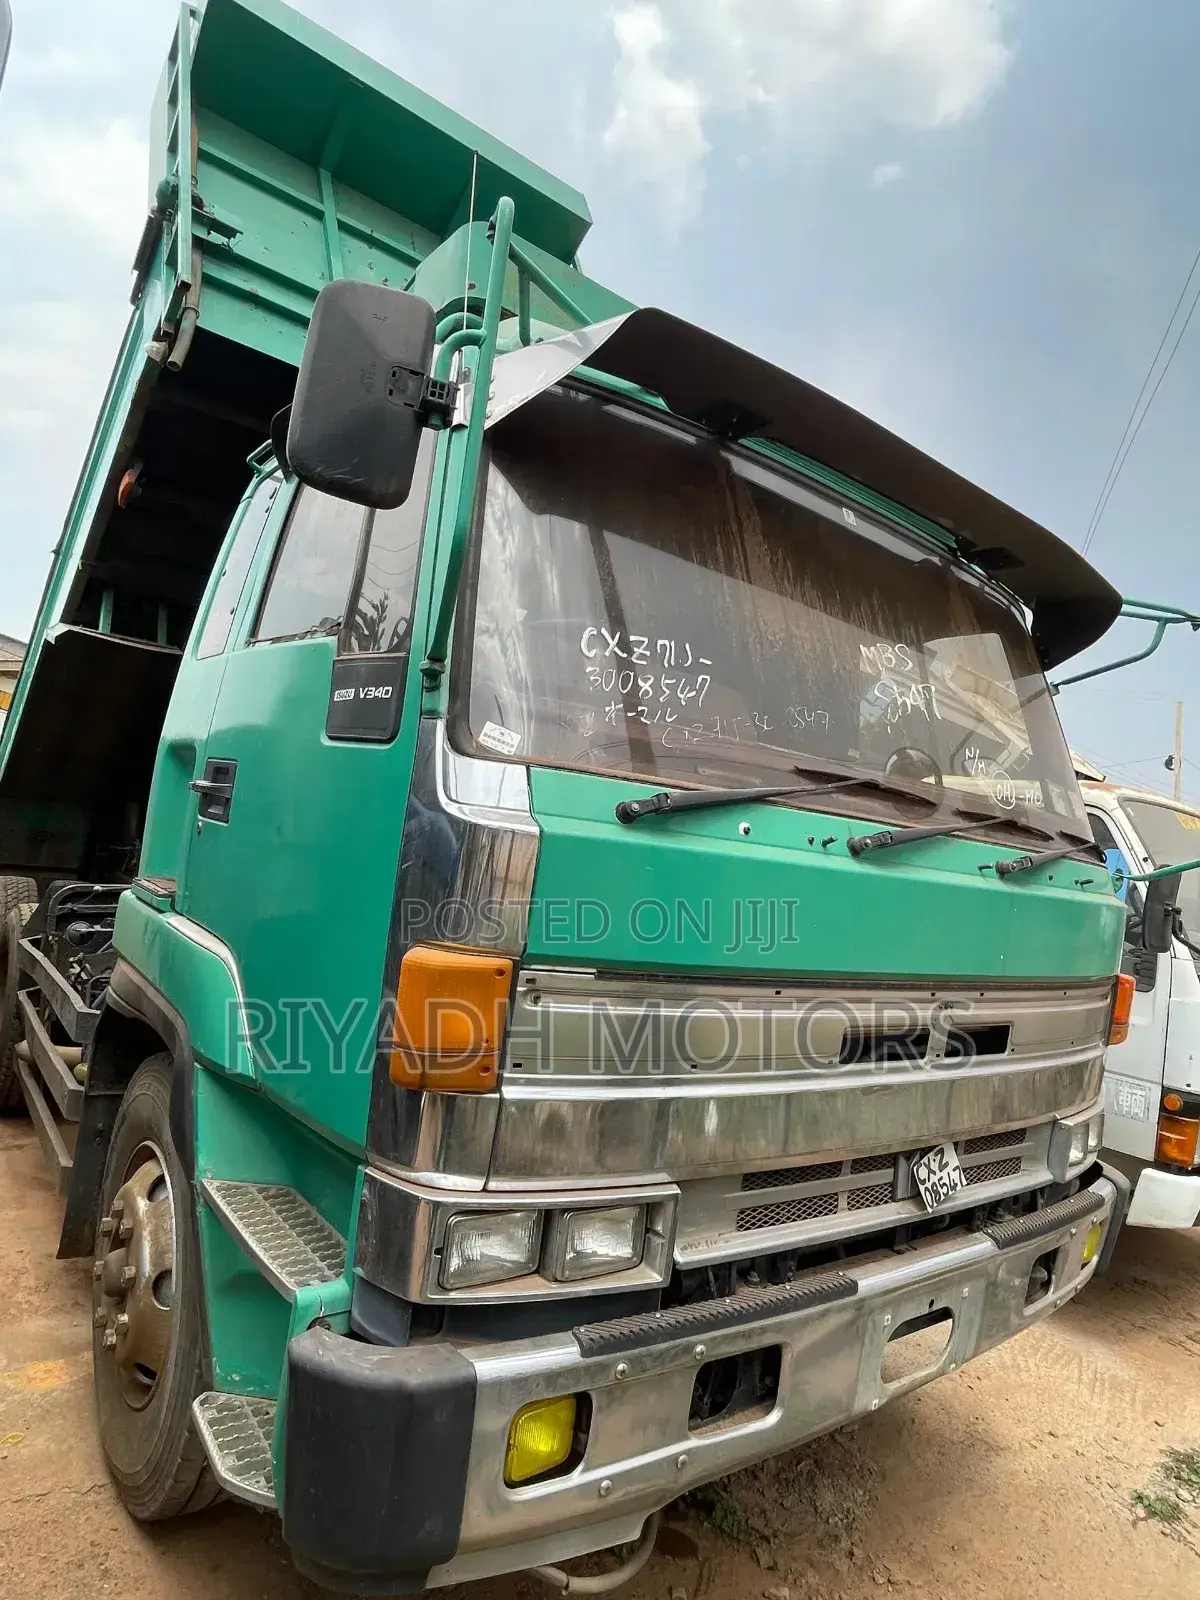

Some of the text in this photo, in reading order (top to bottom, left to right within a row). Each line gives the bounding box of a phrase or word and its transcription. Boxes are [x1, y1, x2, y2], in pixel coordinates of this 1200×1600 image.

[334, 686, 393, 701] ISUZU V340
[585, 665, 711, 708] 3008547
[924, 1164, 965, 1210] 08547
